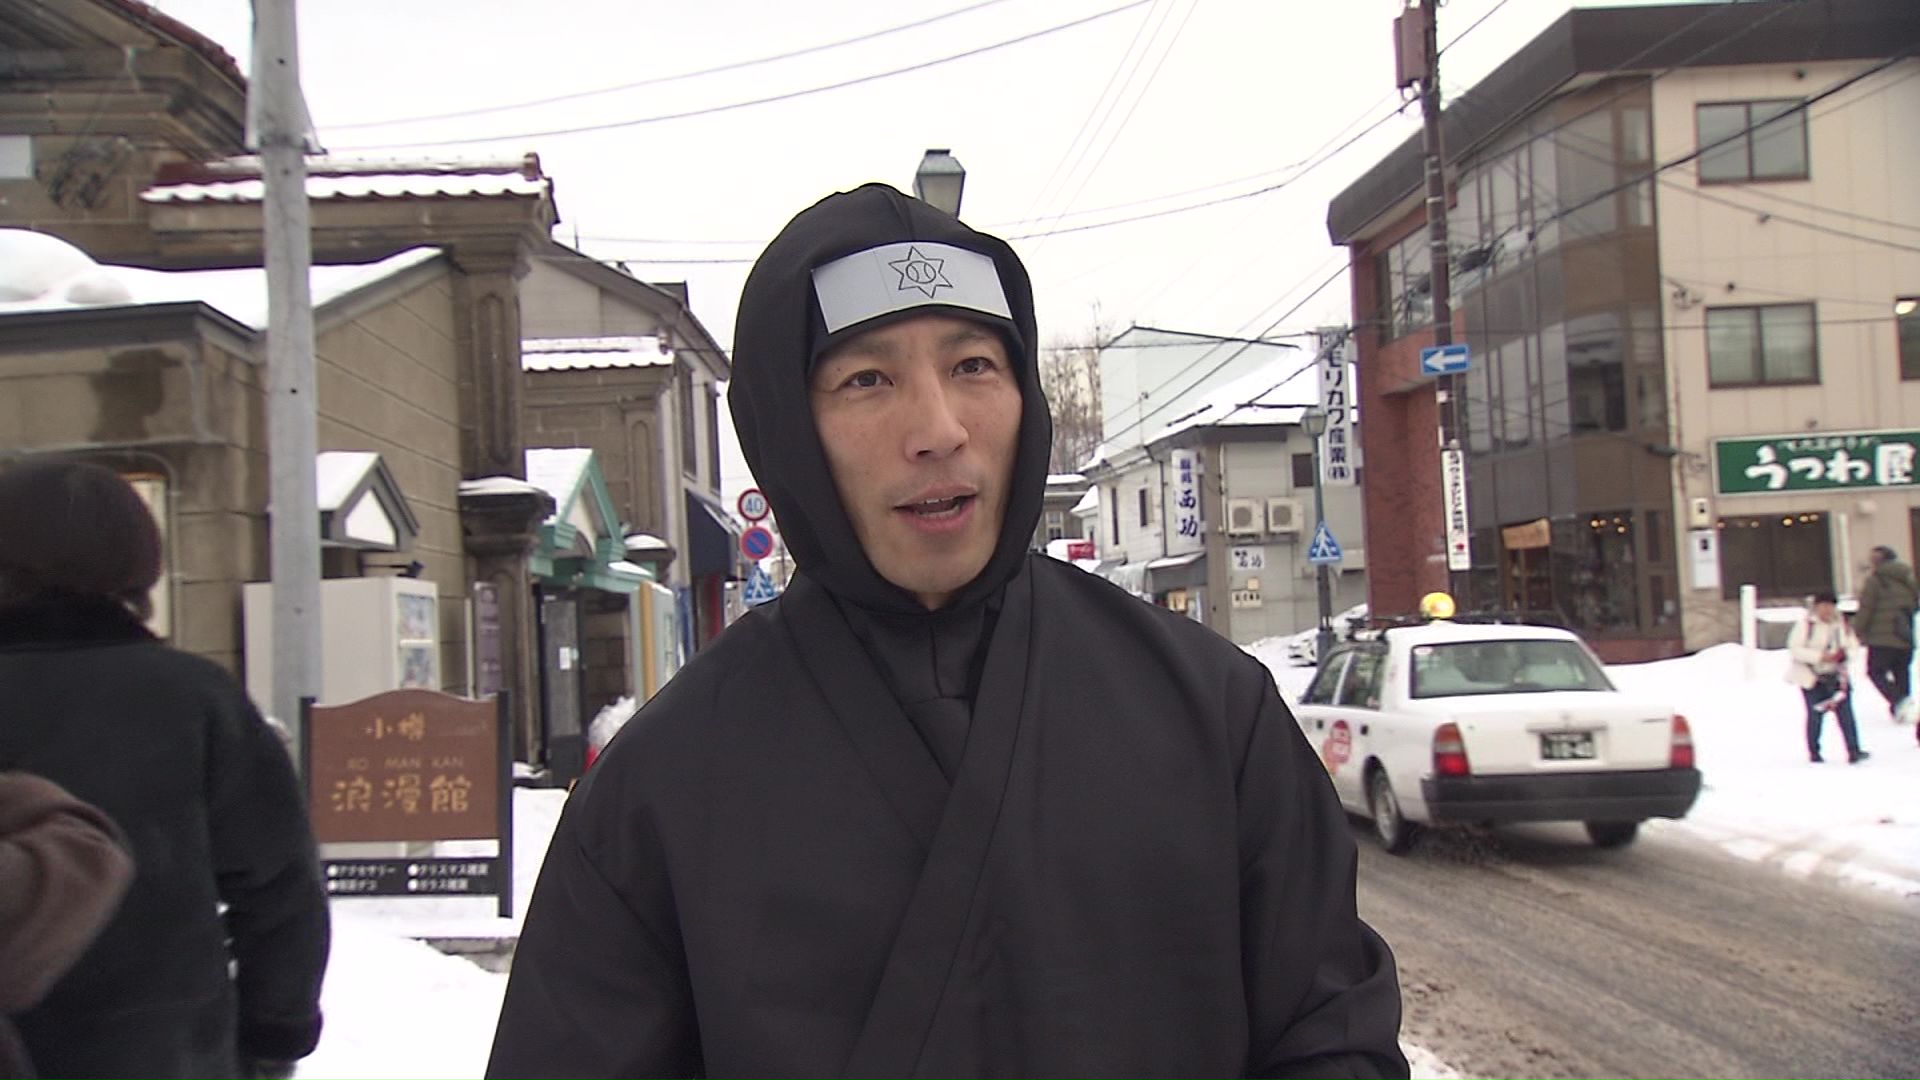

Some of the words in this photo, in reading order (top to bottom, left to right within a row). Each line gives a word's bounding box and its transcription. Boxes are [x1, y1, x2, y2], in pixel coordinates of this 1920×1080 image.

[1744, 443, 1916, 489] うつわ屋
[745, 497, 763, 513] 40
[384, 756, 421, 769] MAN
[431, 756, 464, 768] KAN
[331, 773, 472, 814] 浪漫館
